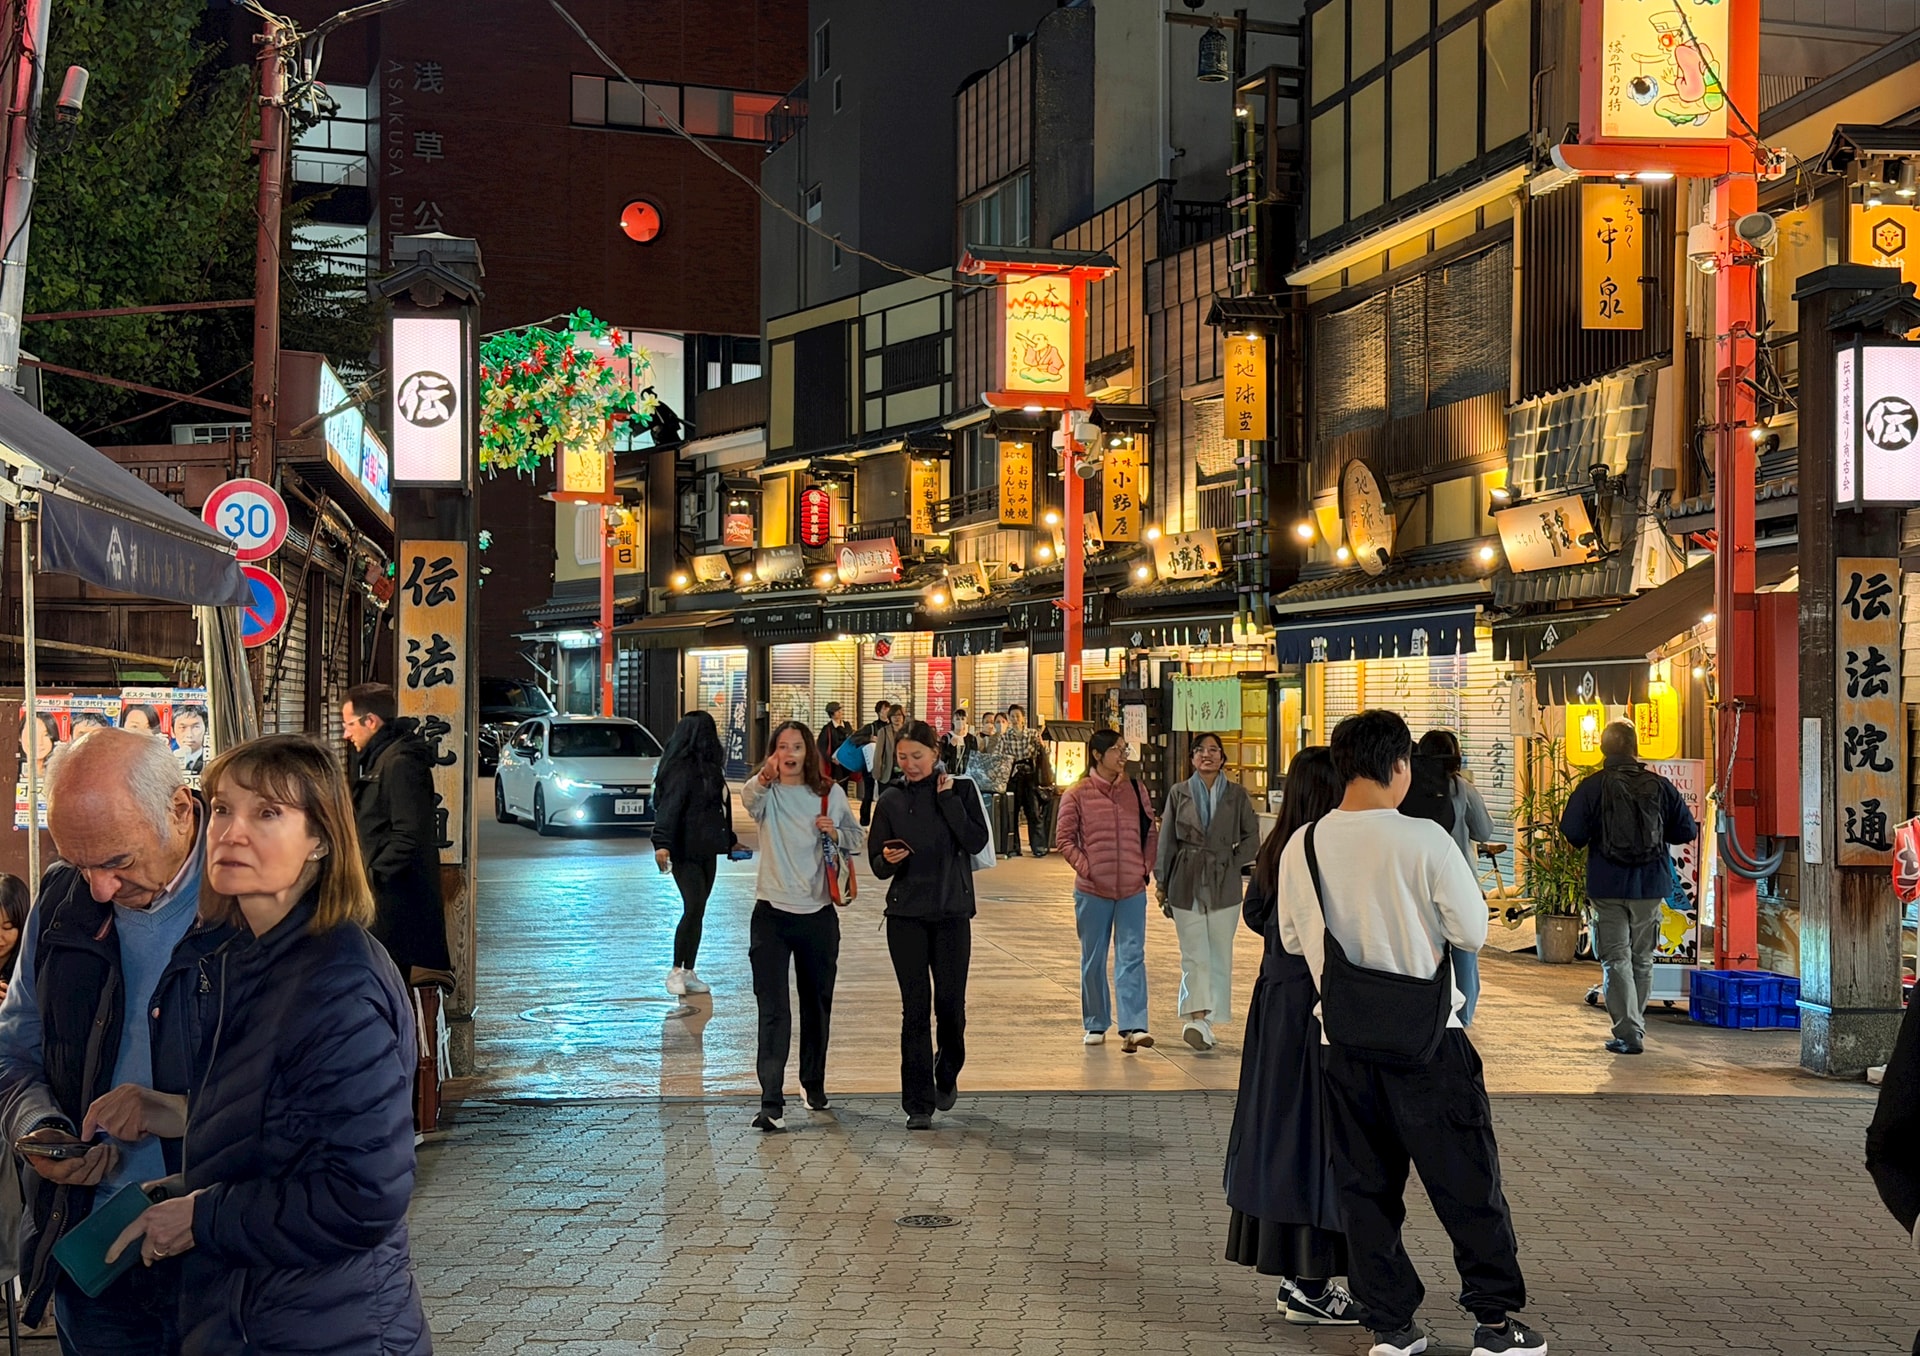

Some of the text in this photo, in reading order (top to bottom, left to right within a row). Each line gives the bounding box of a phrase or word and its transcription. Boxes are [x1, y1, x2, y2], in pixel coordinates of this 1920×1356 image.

[387, 60, 404, 176] ASAKUSA
[1623, 194, 1635, 248] みちのく
[1597, 217, 1625, 319] 平泉
[401, 375, 451, 421] 伝
[1233, 362, 1256, 431] 地球堂
[1866, 401, 1913, 444] 伝
[1004, 465, 1016, 519] もんじゃ焼
[1017, 465, 1029, 519] お好み焼
[1112, 471, 1132, 536] 小野屋
[224, 503, 270, 538] 30
[1842, 572, 1895, 852] 伝法院通
